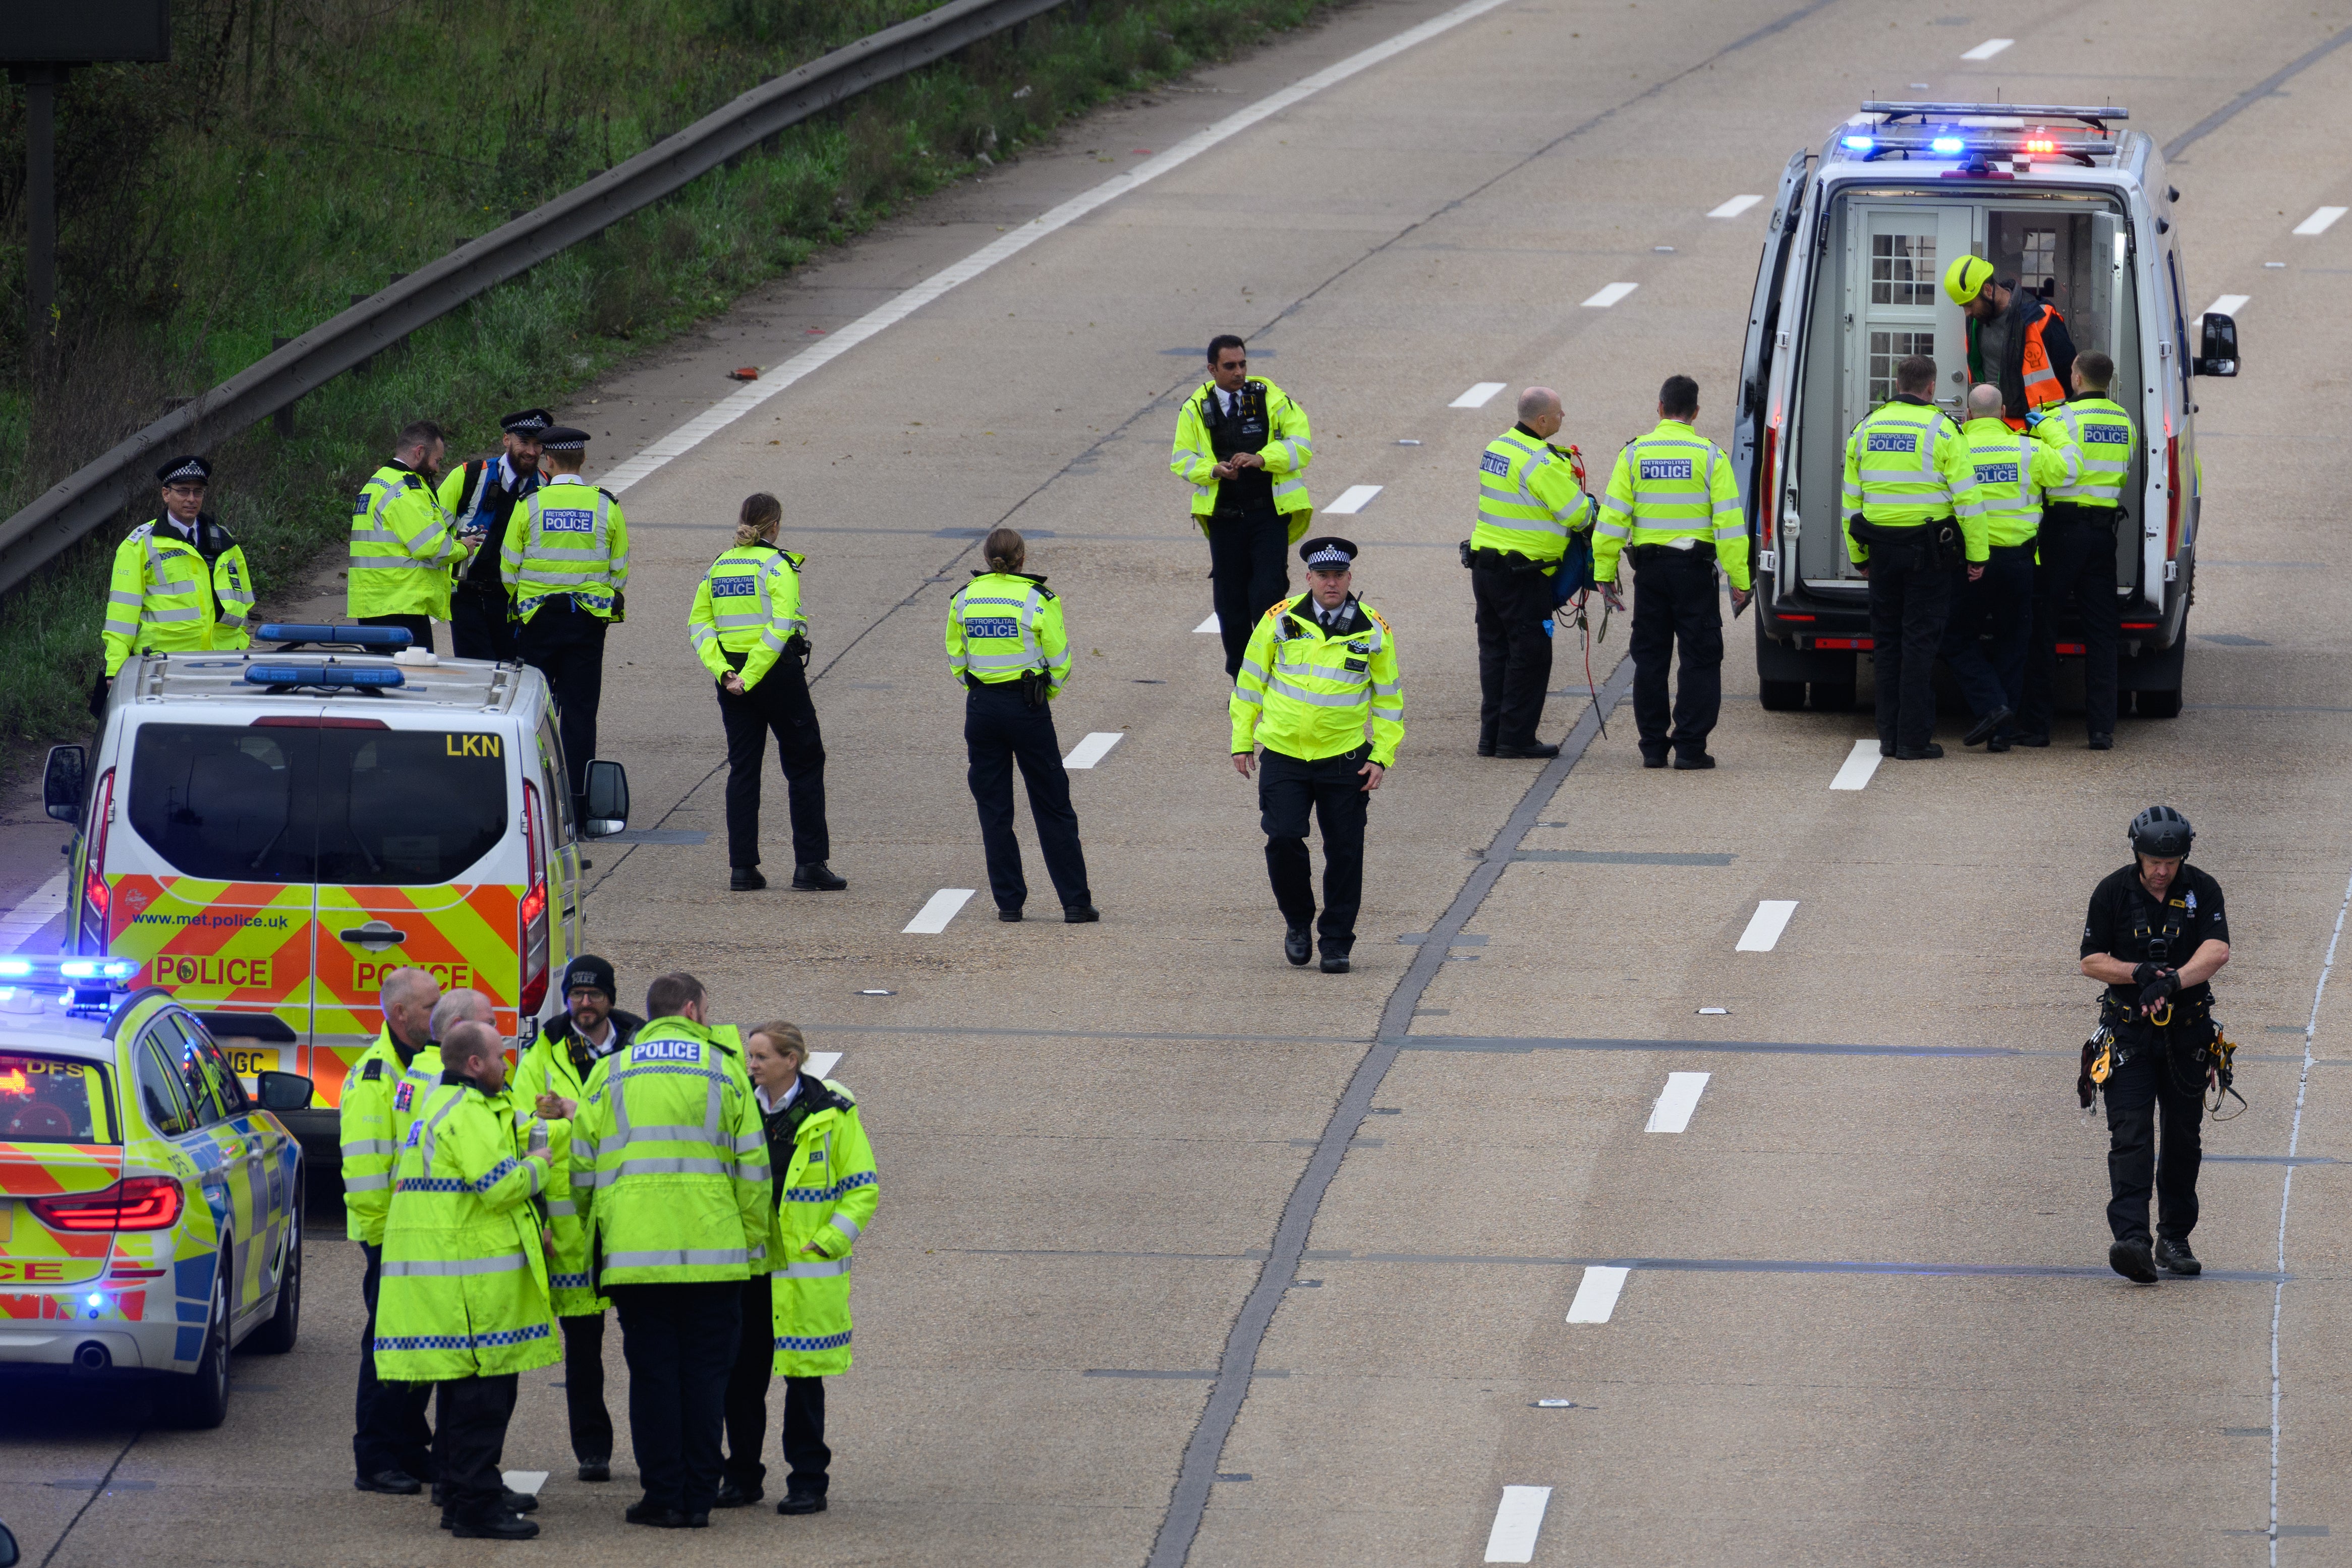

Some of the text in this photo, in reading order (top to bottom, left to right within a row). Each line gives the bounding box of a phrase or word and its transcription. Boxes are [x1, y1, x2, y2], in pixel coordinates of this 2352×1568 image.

[2085, 430, 2127, 443] POLICE
[1868, 439, 1915, 451] POLICE
[1480, 456, 1507, 476] POLICE
[1641, 465, 1690, 478] POLICE
[1974, 463, 2017, 472] TROPOLITAN
[1976, 470, 2017, 483] OLICE
[546, 517, 589, 530] POLICE
[712, 583, 754, 597] POLICE
[966, 625, 1017, 636] POLICE
[446, 734, 499, 758] LKN
[132, 914, 289, 928] www.met.police.uk
[157, 956, 267, 985] POLICE
[358, 962, 468, 992] POCE
[634, 1042, 698, 1060] POLICE
[27, 1060, 84, 1077] DFS
